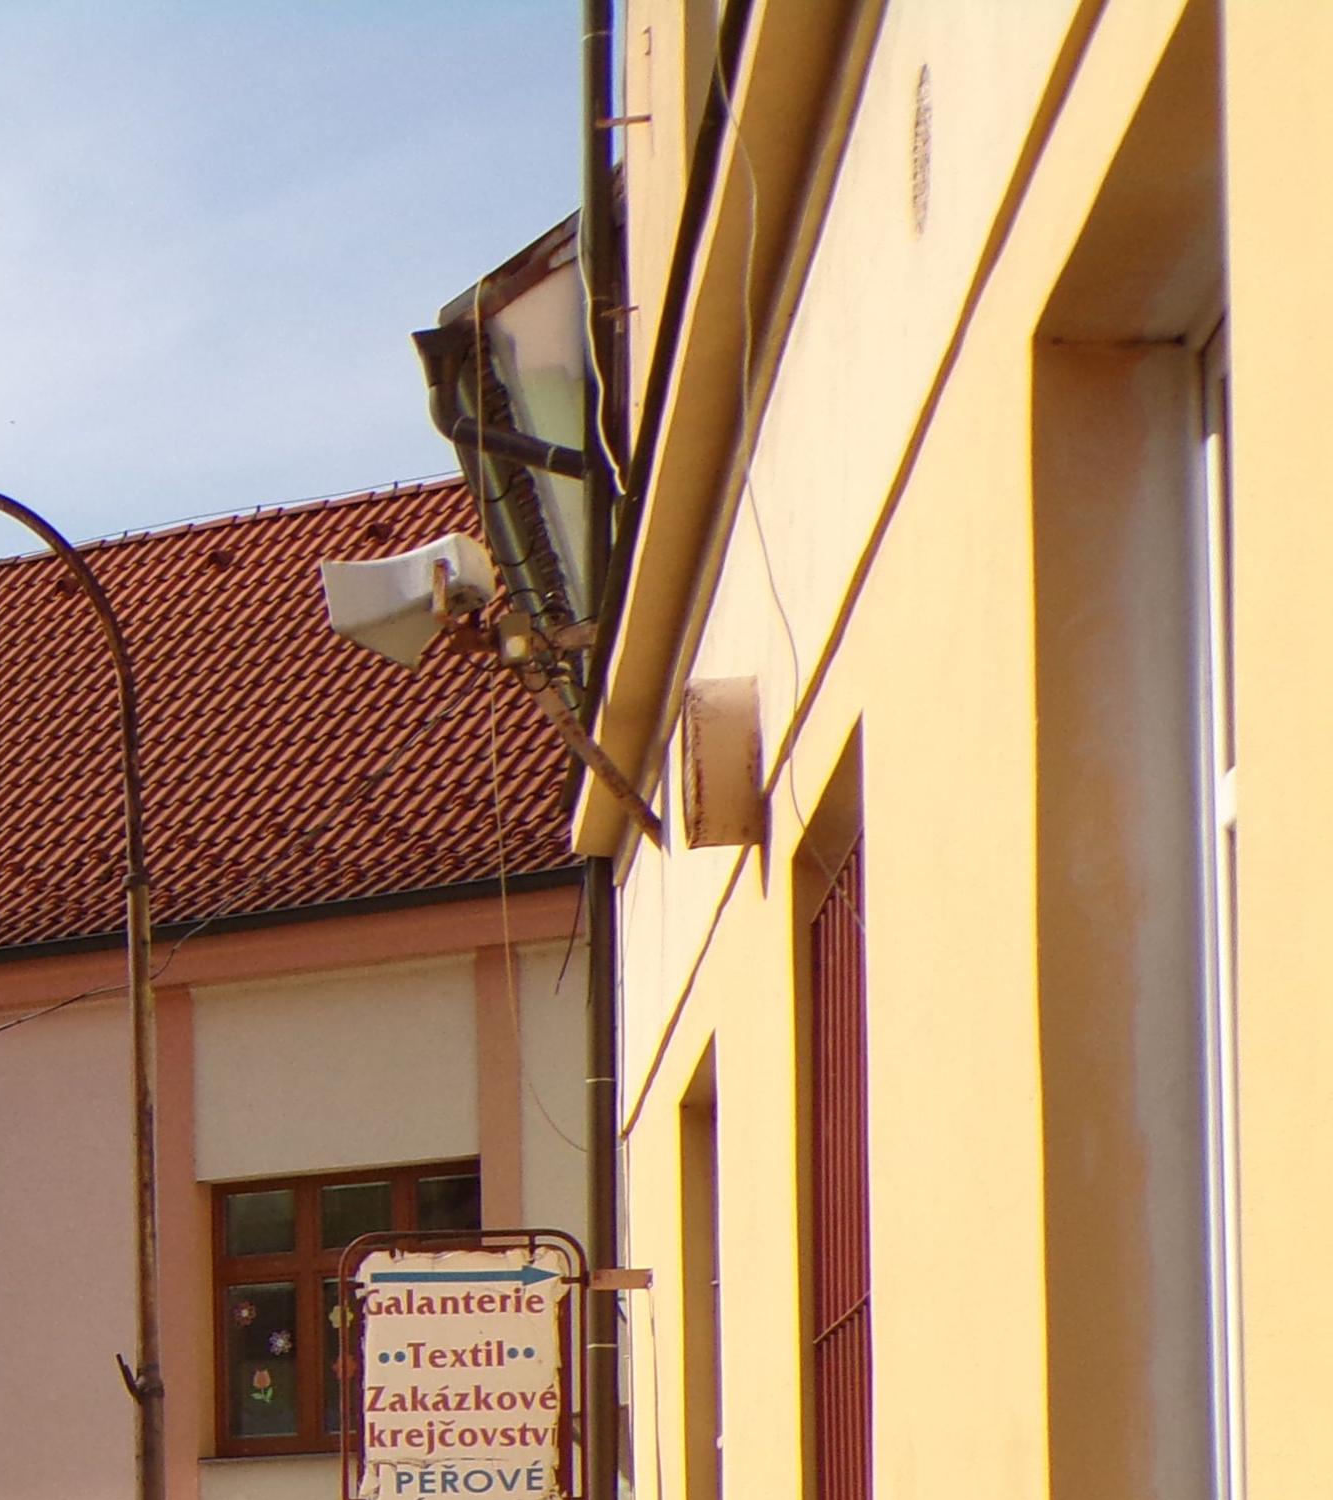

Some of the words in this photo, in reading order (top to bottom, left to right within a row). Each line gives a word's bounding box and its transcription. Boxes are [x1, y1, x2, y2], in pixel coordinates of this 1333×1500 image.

[366, 1287, 545, 1316] Galanterie
[406, 1340, 505, 1369] Textil
[367, 1384, 558, 1413] Zakázkové
[395, 1460, 544, 1495] PÉŘOVÉ
